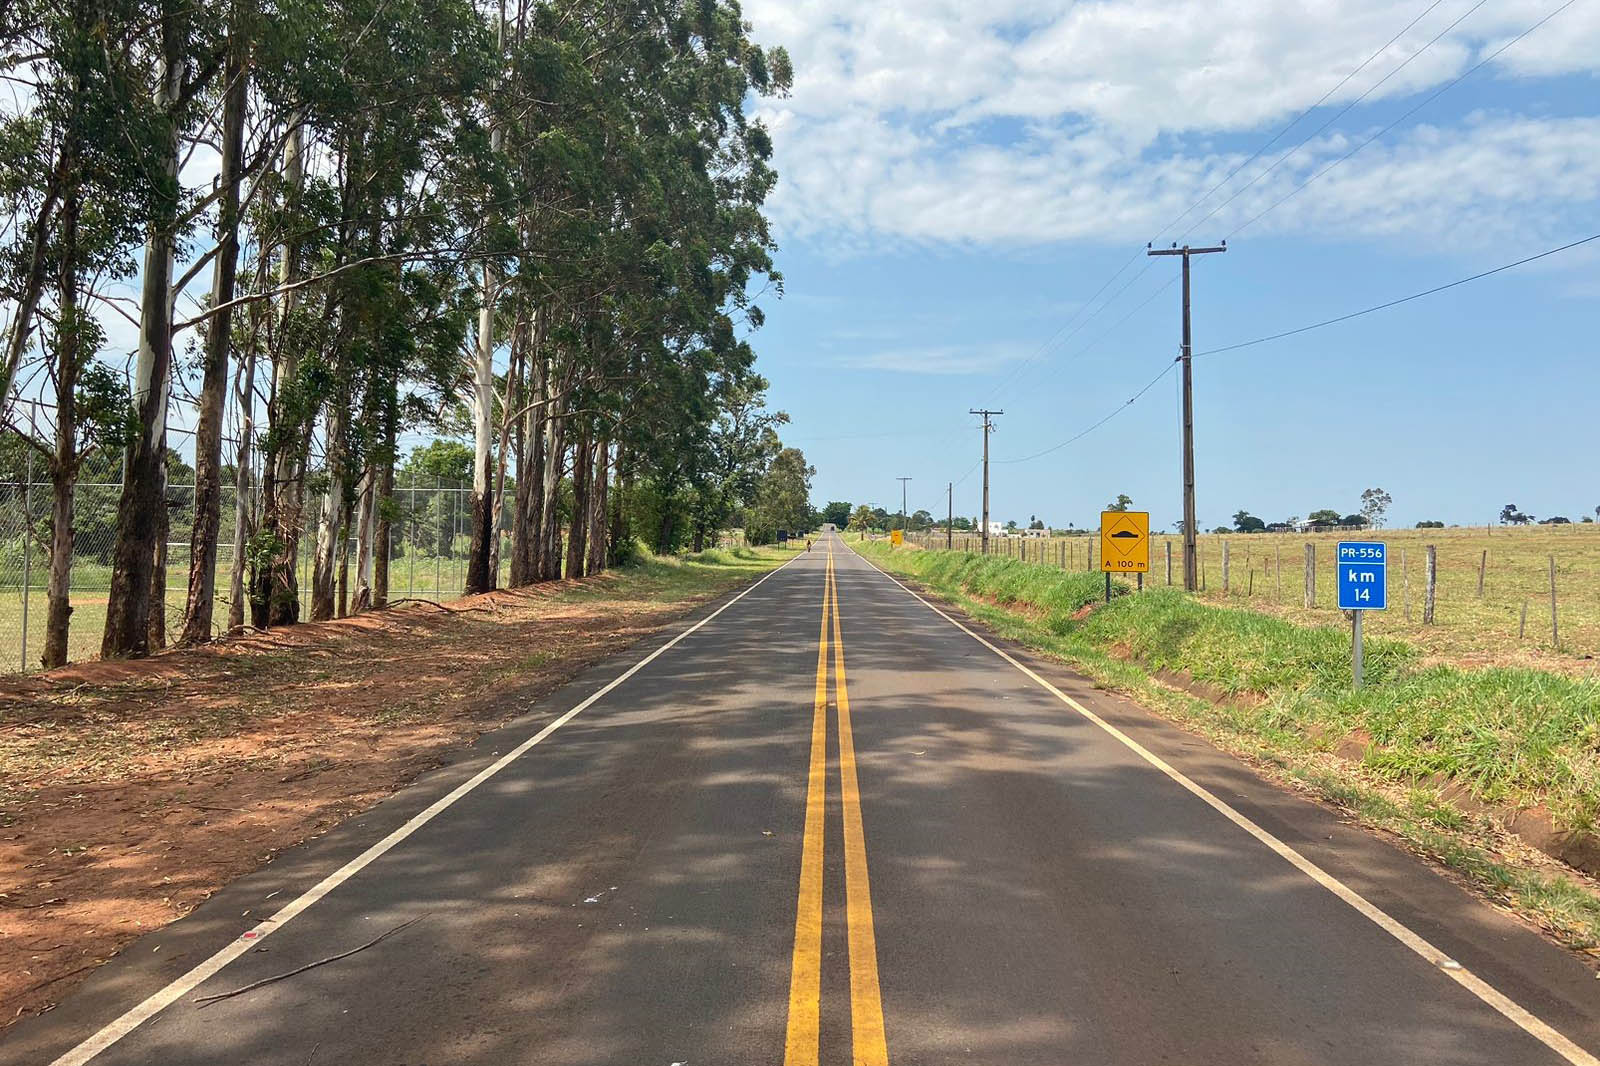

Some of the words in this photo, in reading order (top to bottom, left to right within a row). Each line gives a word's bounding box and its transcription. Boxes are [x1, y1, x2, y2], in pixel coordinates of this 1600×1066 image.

[1341, 547, 1382, 558] PR-556
[1105, 560, 1112, 568] A
[1117, 560, 1134, 568] 100
[1349, 569, 1375, 582] km
[1354, 588, 1370, 602] 14
